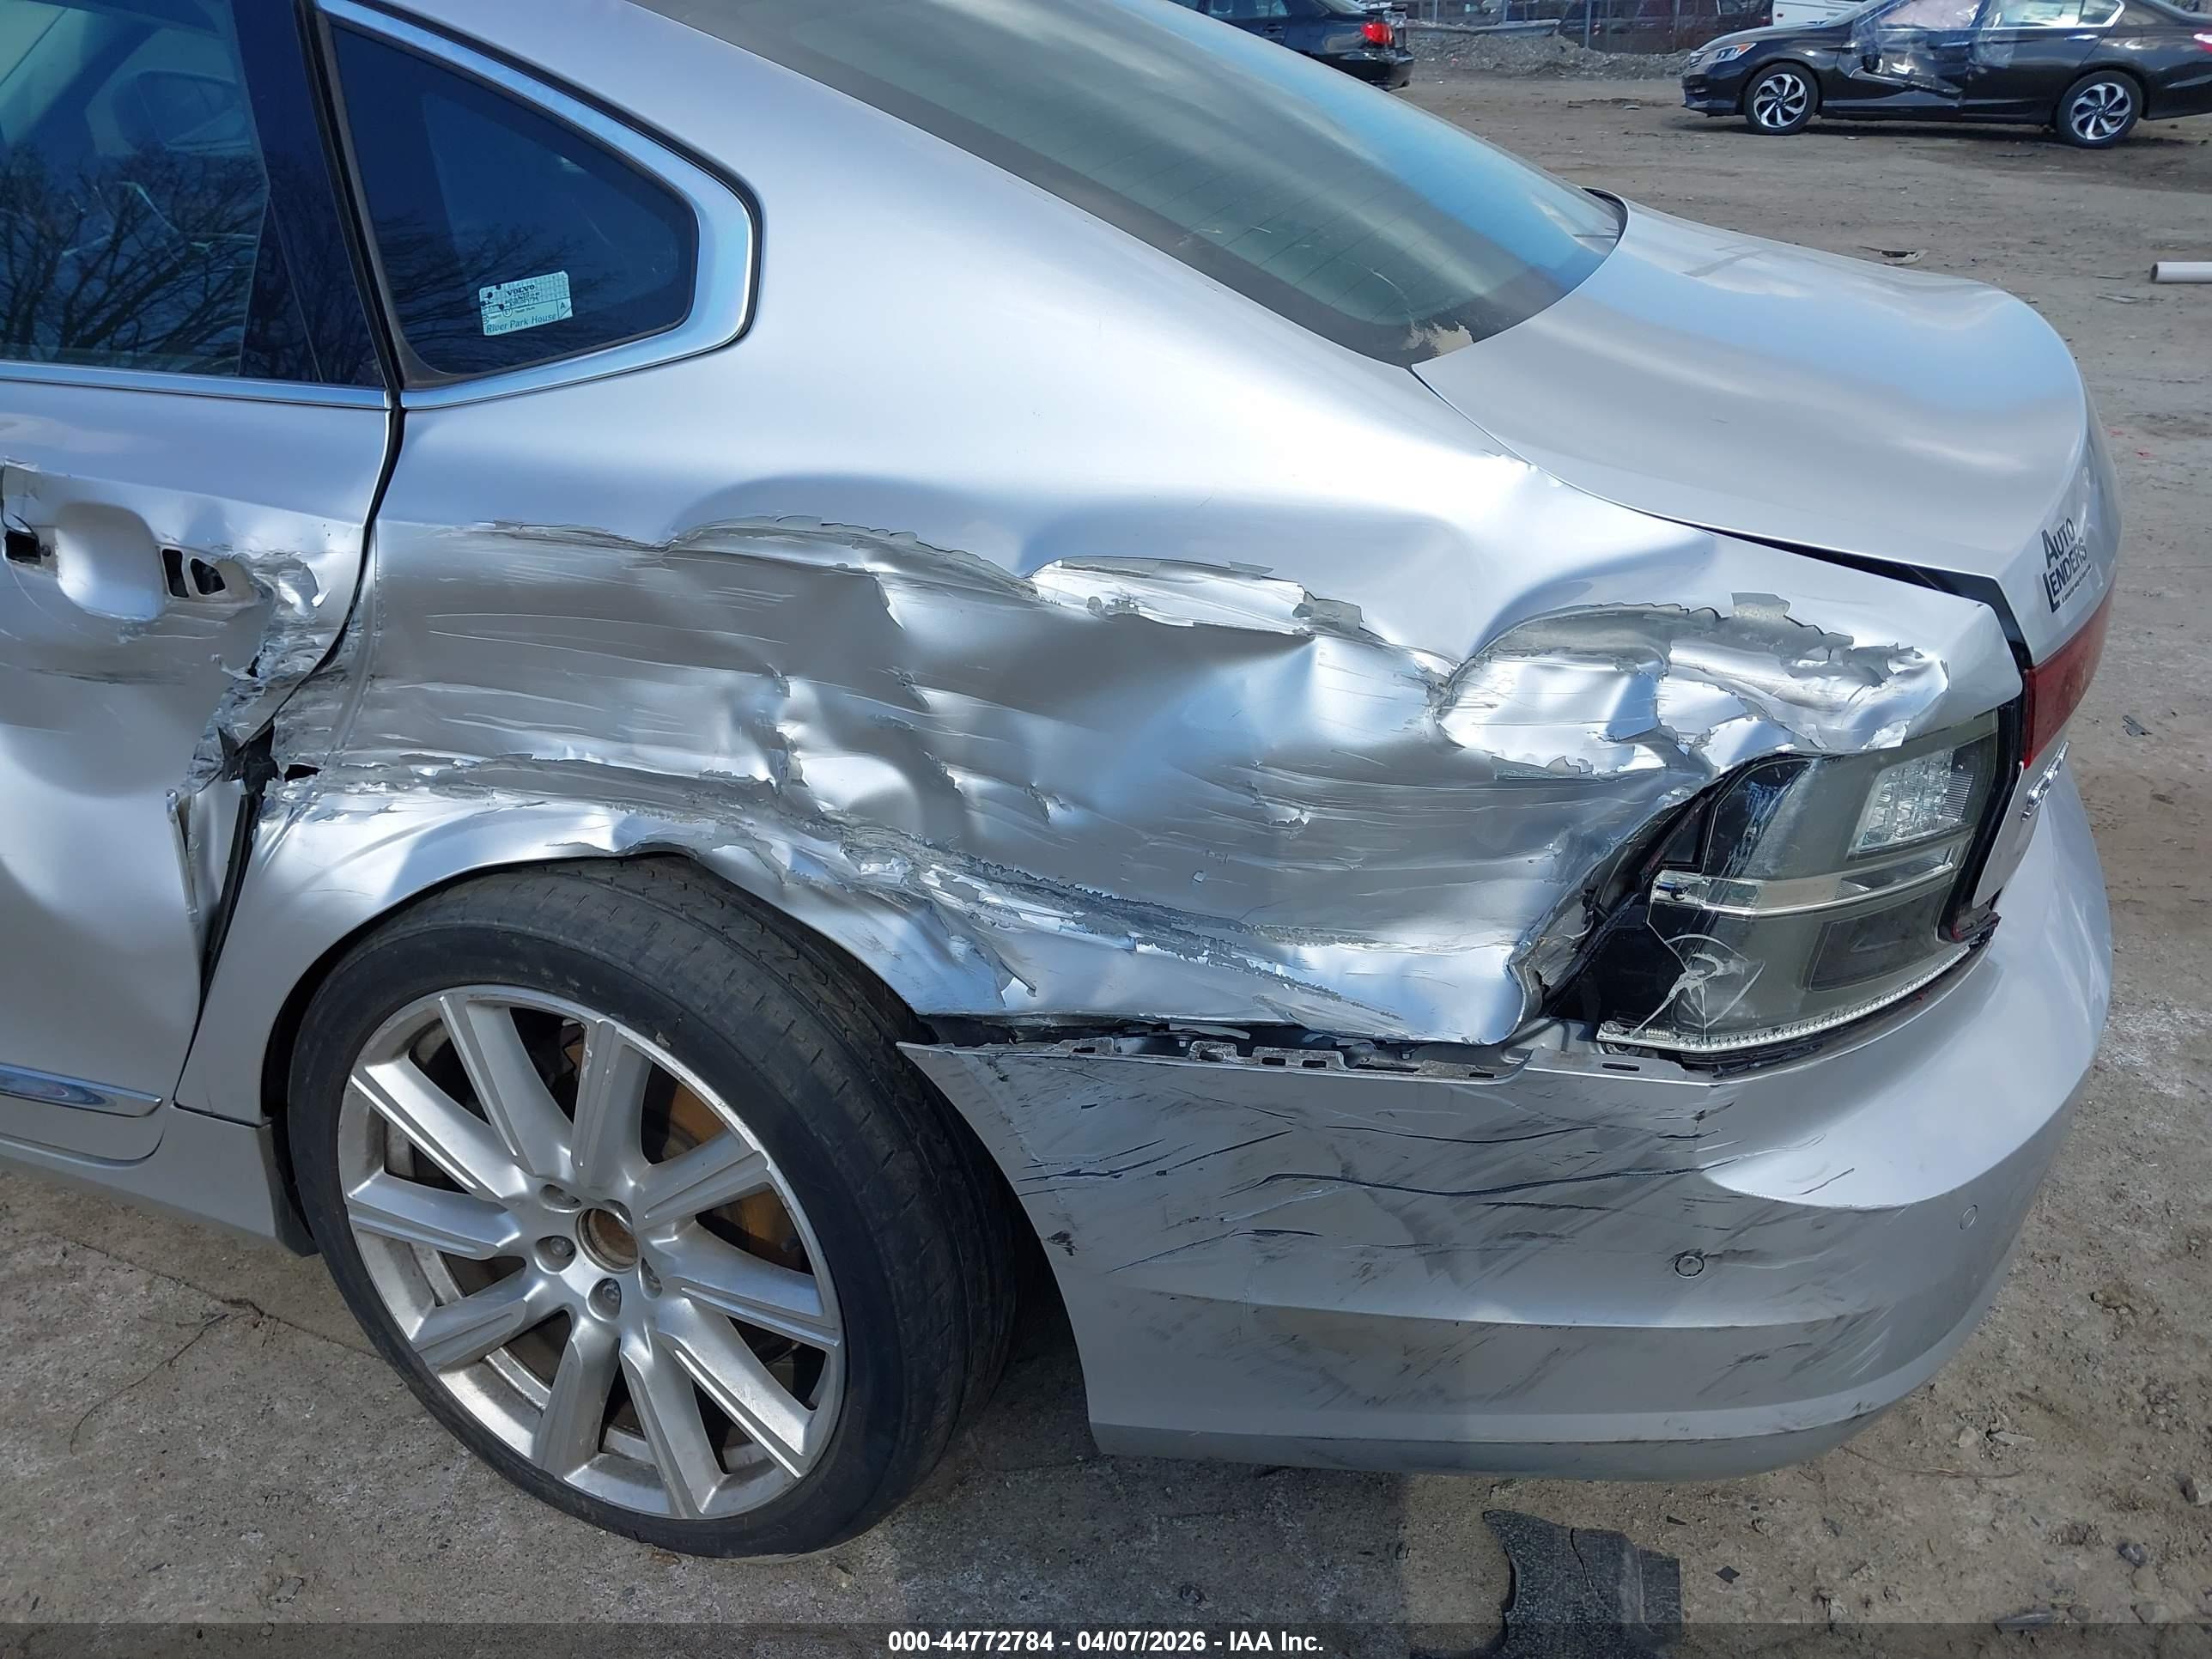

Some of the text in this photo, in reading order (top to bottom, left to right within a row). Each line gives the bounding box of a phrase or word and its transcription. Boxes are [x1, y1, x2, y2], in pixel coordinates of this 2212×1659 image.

[507, 283, 536, 296] VOLVO
[509, 318, 529, 329] Park
[532, 313, 557, 324] House
[2041, 517, 2075, 569] AUTO
[2042, 537, 2088, 613] LENDERS
